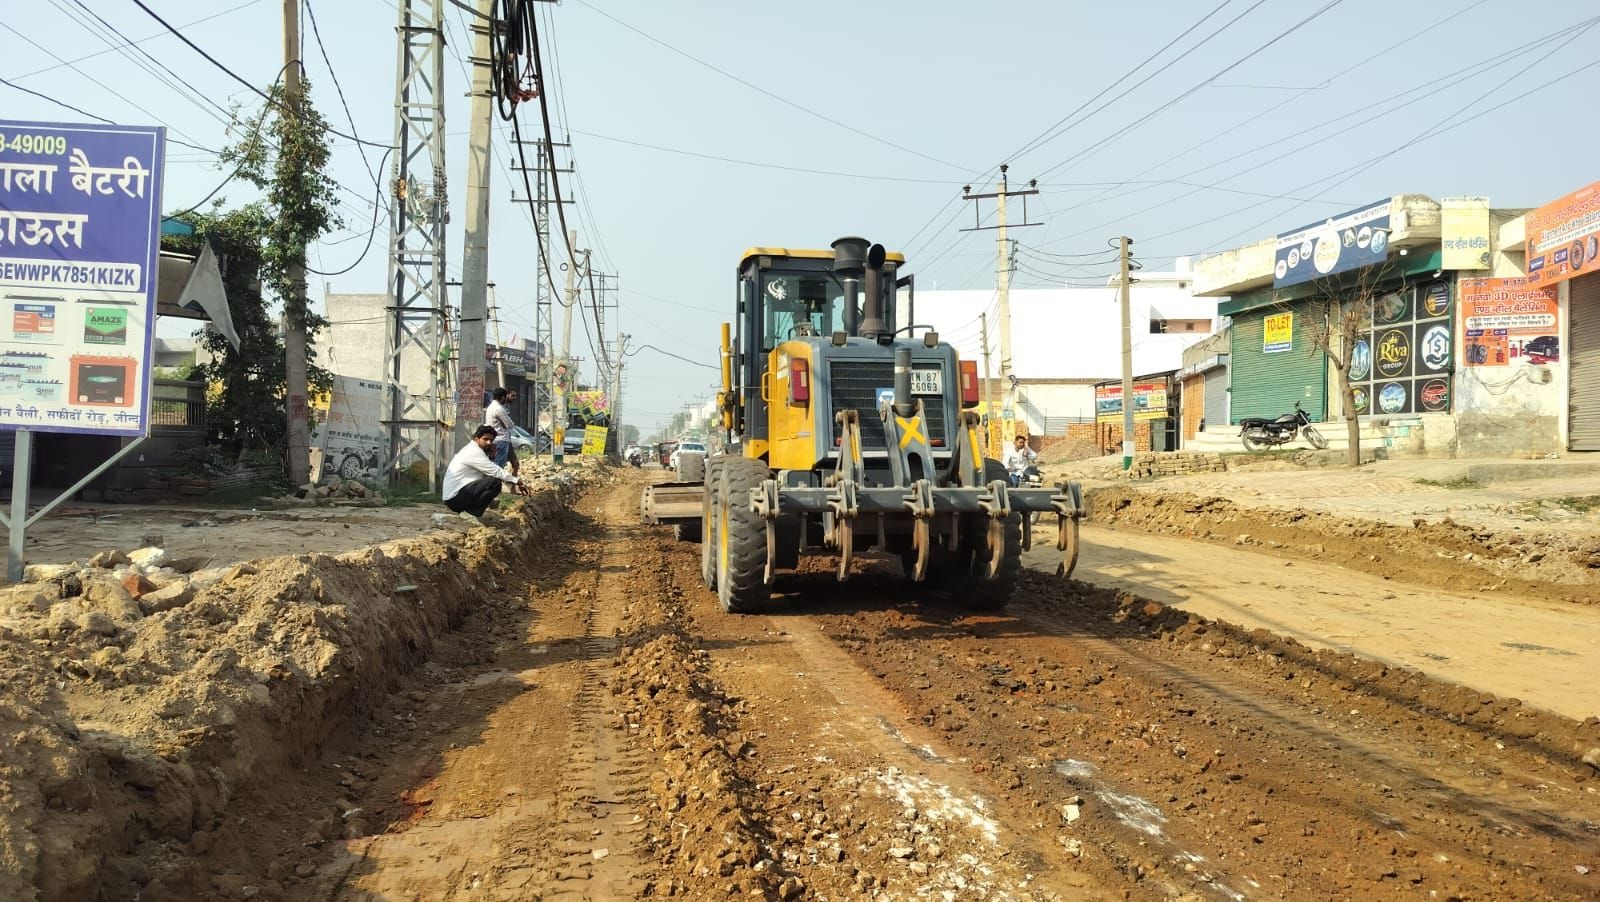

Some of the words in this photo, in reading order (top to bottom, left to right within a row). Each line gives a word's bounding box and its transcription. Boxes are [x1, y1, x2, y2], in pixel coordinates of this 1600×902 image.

[69, 148, 149, 199] बैटरी
[1494, 292, 1508, 301] 3D
[90, 315, 123, 324] AMAZE
[1379, 342, 1408, 363] Riya
[927, 372, 936, 381] 87
